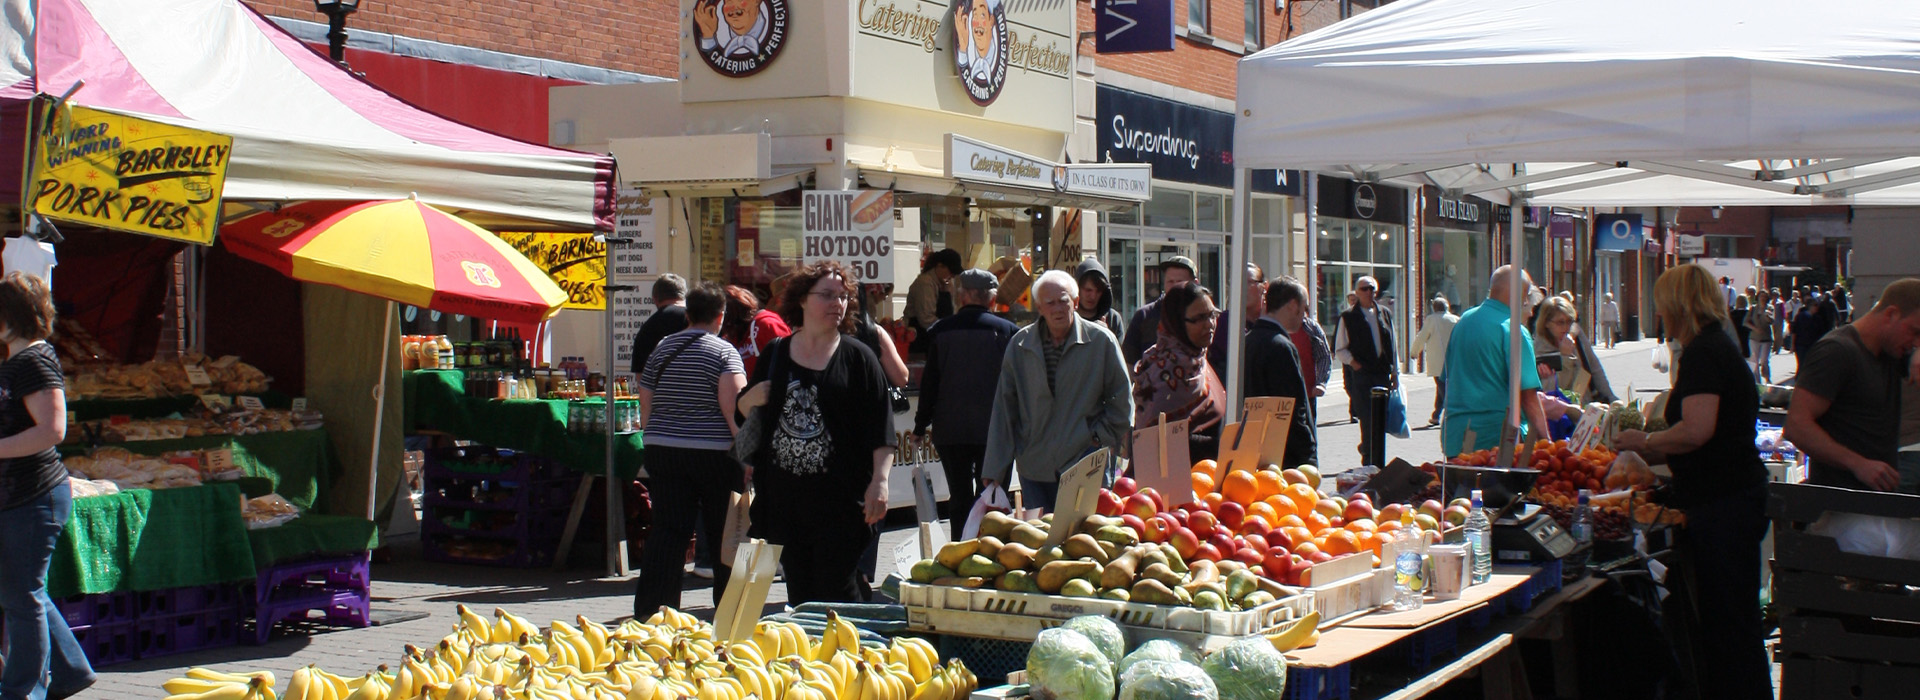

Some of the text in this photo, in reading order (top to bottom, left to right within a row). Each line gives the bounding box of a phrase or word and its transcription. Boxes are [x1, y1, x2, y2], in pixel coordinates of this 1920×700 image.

[858, 0, 940, 53] Catering
[710, 51, 756, 71] CATERING
[962, 13, 1007, 100] CATERING PERFECTION
[1007, 30, 1070, 74] Perfection
[49, 136, 122, 168] WINNING
[1113, 115, 1199, 169] Superdrug
[115, 145, 229, 176] BARNSLEY
[970, 152, 1041, 180] Catering Perfection
[1072, 173, 1080, 184] IN
[1081, 174, 1087, 185] A
[1088, 174, 1108, 188] CLASS
[1109, 176, 1117, 189] OF
[32, 178, 190, 230] PORK PIES
[805, 194, 853, 232] GIANT
[1439, 195, 1479, 222] RIVER ISLAND
[621, 219, 639, 227] MENU
[628, 254, 643, 262] DOGS
[805, 235, 891, 257] HOTDOG
[615, 309, 627, 317] HIPS
[615, 321, 627, 329] HIPS
[1171, 423, 1184, 434] 165
[1090, 453, 1104, 467] 110
